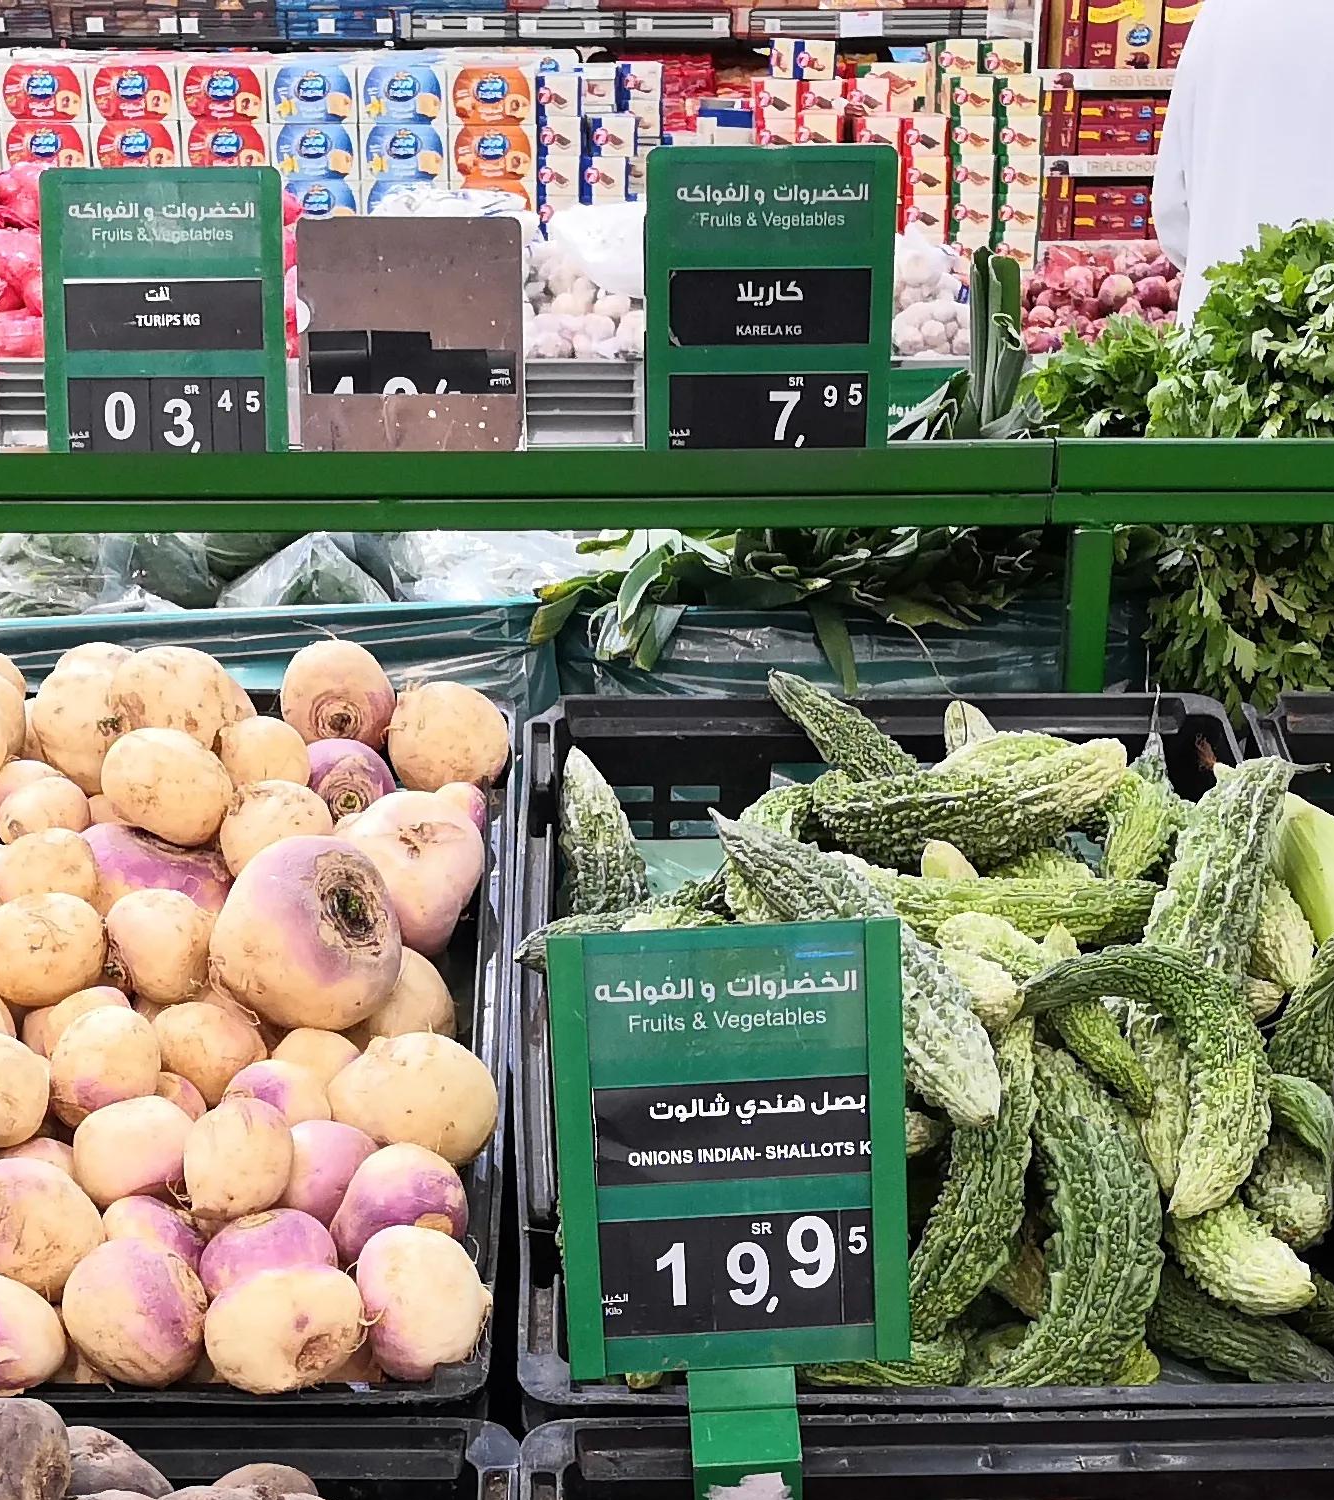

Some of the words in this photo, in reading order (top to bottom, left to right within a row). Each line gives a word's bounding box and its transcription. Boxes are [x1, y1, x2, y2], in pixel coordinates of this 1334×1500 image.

[677, 182, 749, 205] الفواكه
[773, 183, 869, 204] الخضروات
[68, 202, 139, 221] الفواكه
[162, 202, 255, 220] الخضروات
[699, 212, 742, 228] Fruits
[746, 212, 761, 227] &
[764, 211, 845, 230] Vegetables
[92, 227, 133, 241] Fruits
[137, 227, 150, 241] &
[153, 227, 233, 244] Vegetables
[736, 280, 804, 306] كاريلا
[135, 313, 181, 327] TURIPS
[183, 313, 200, 326] KG
[736, 325, 783, 336] KARELA
[785, 325, 802, 336] KG
[184, 384, 200, 395] SR
[788, 376, 804, 387] SR
[594, 976, 694, 1004] الفواكه
[701, 983, 716, 1003] و
[727, 969, 858, 1000] الخضروات
[628, 1012, 687, 1033] Fruits
[692, 1012, 708, 1031] &
[713, 1007, 827, 1032] Vegetables
[649, 1092, 730, 1122] شالوت
[736, 1094, 806, 1124] هندي
[811, 1092, 867, 1115] بصل
[628, 1150, 693, 1167] ONIONS
[765, 1141, 856, 1160] SHALLOTS
[859, 1140, 872, 1156] K
[751, 1221, 772, 1235] SR
